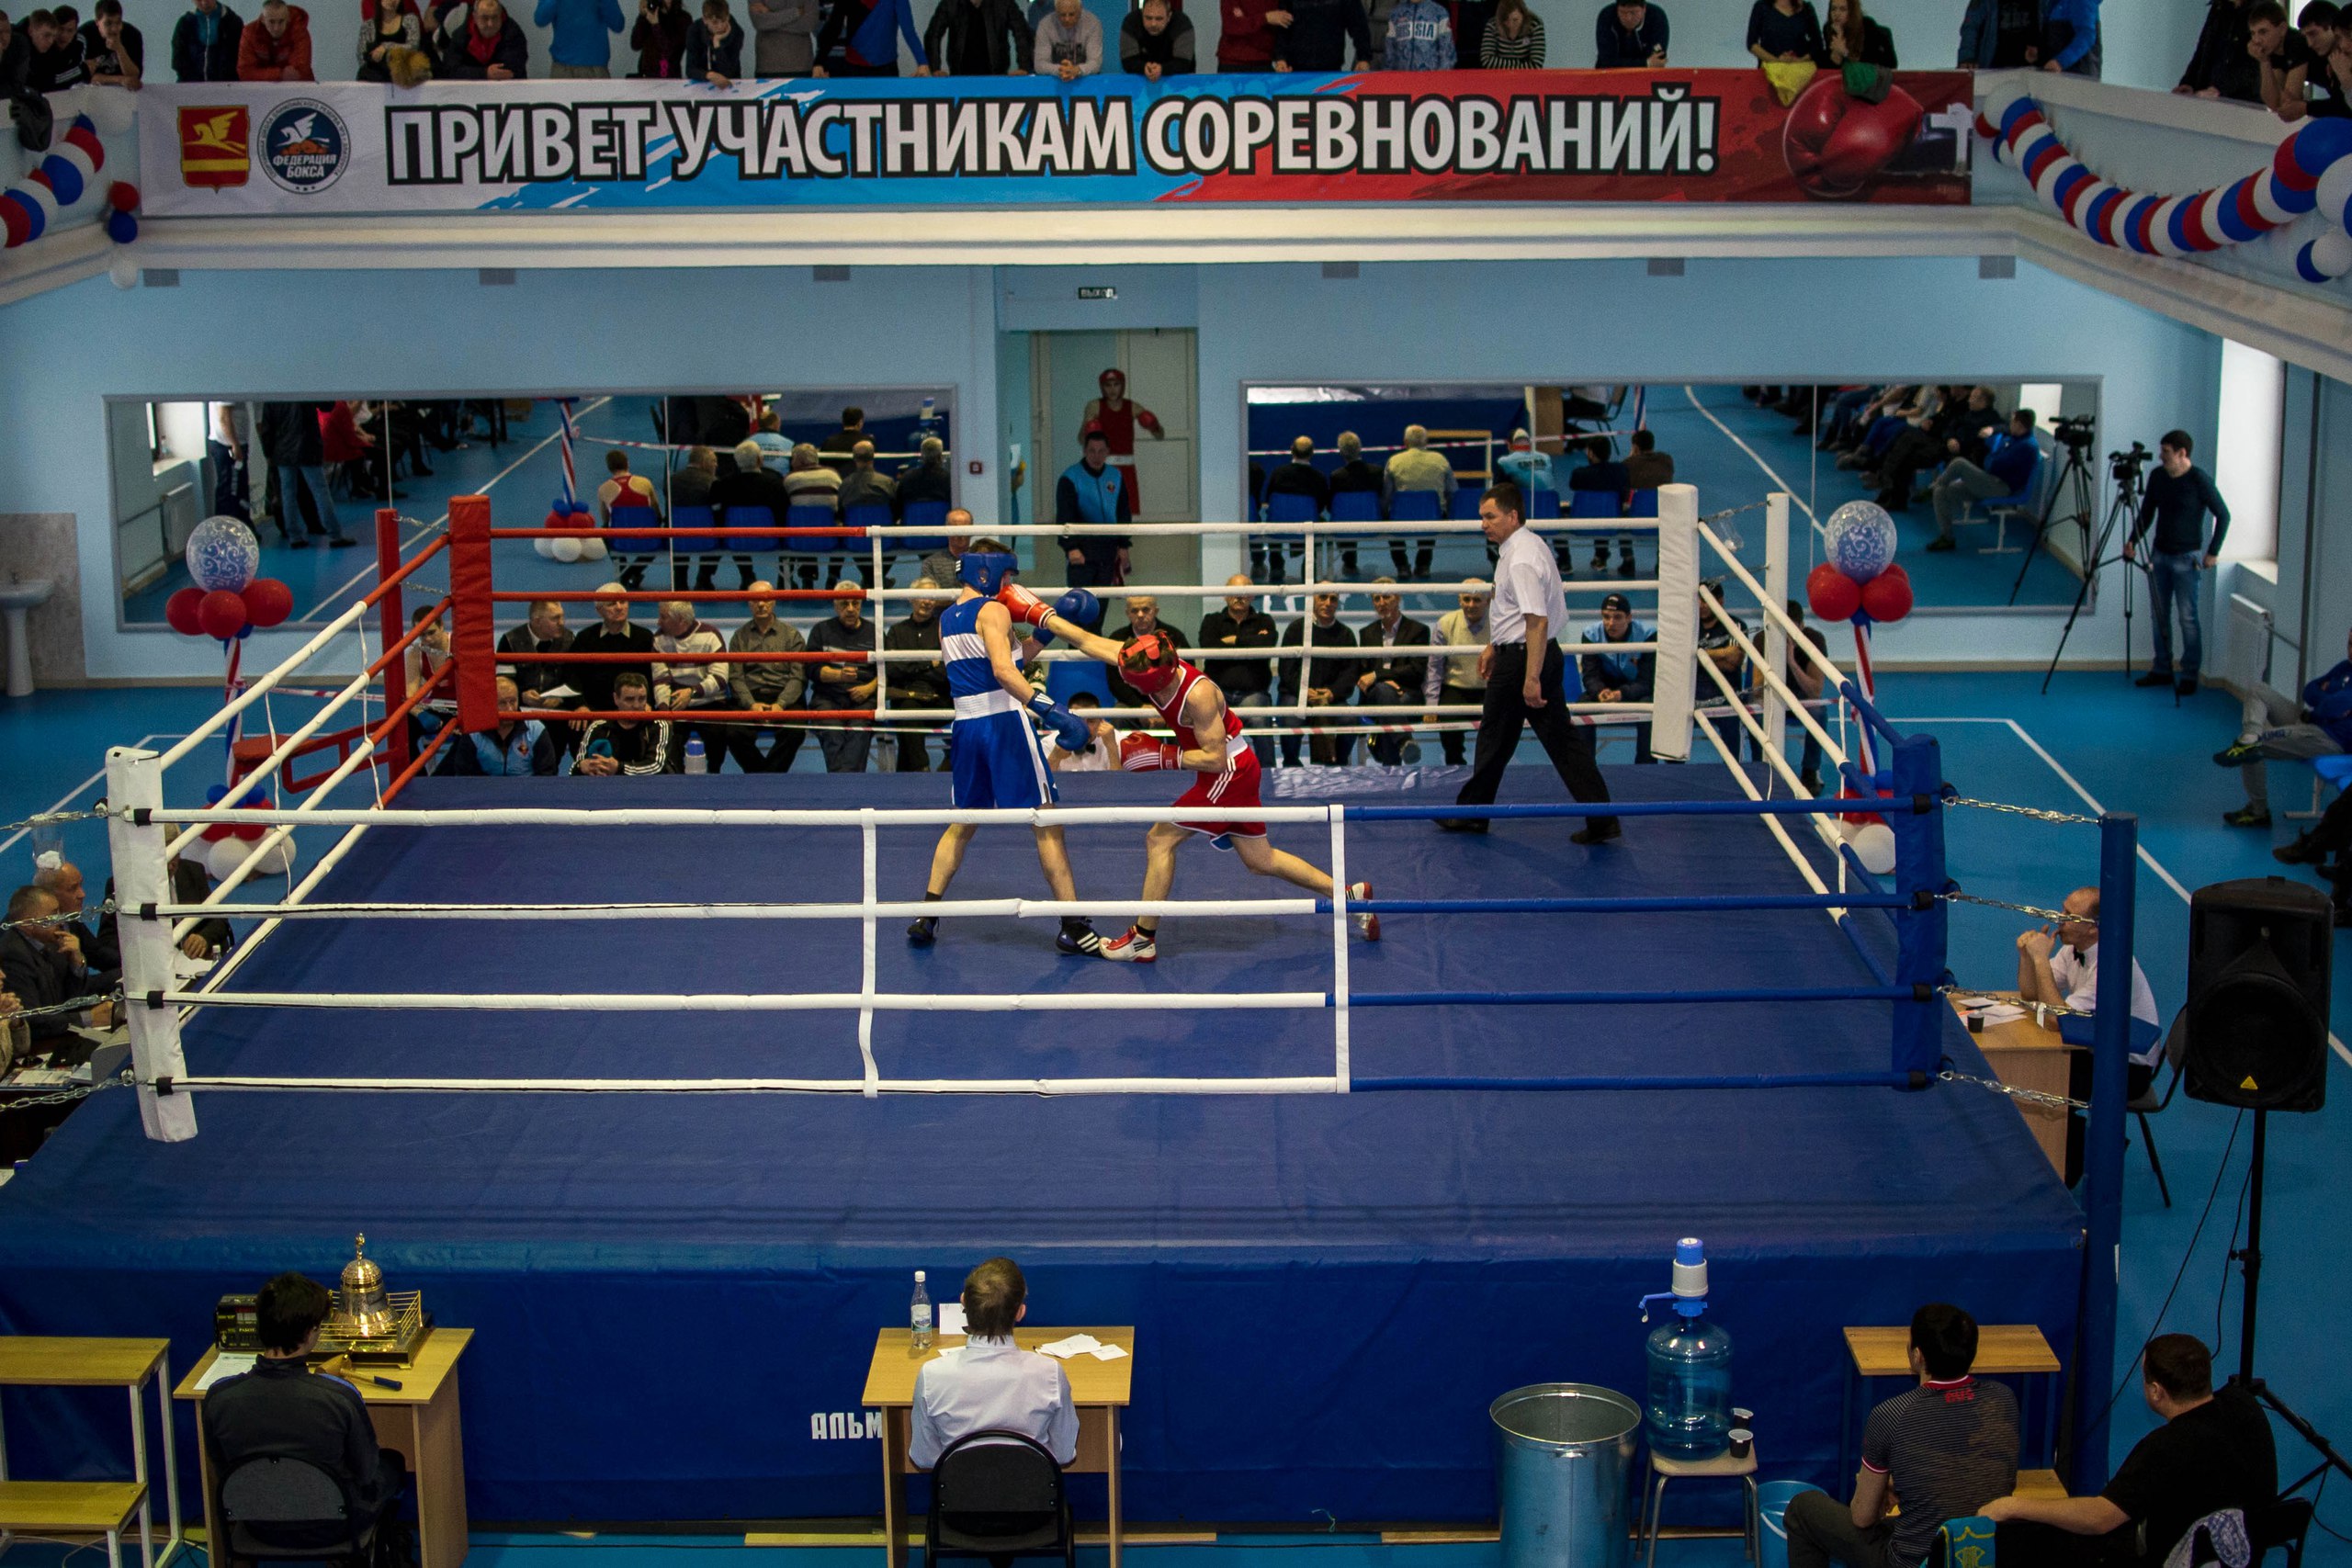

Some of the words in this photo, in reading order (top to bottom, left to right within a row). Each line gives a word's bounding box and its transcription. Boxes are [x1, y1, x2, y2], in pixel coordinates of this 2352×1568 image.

[386, 102, 657, 185] ПРИВЕТ
[664, 97, 1136, 180] УЧАСТНИКАМ
[1141, 83, 1719, 175] СОРЕВНОВАНИЙ!
[273, 154, 337, 166] ФЕДЕРАЦИЯ
[287, 166, 324, 178] БОКСА
